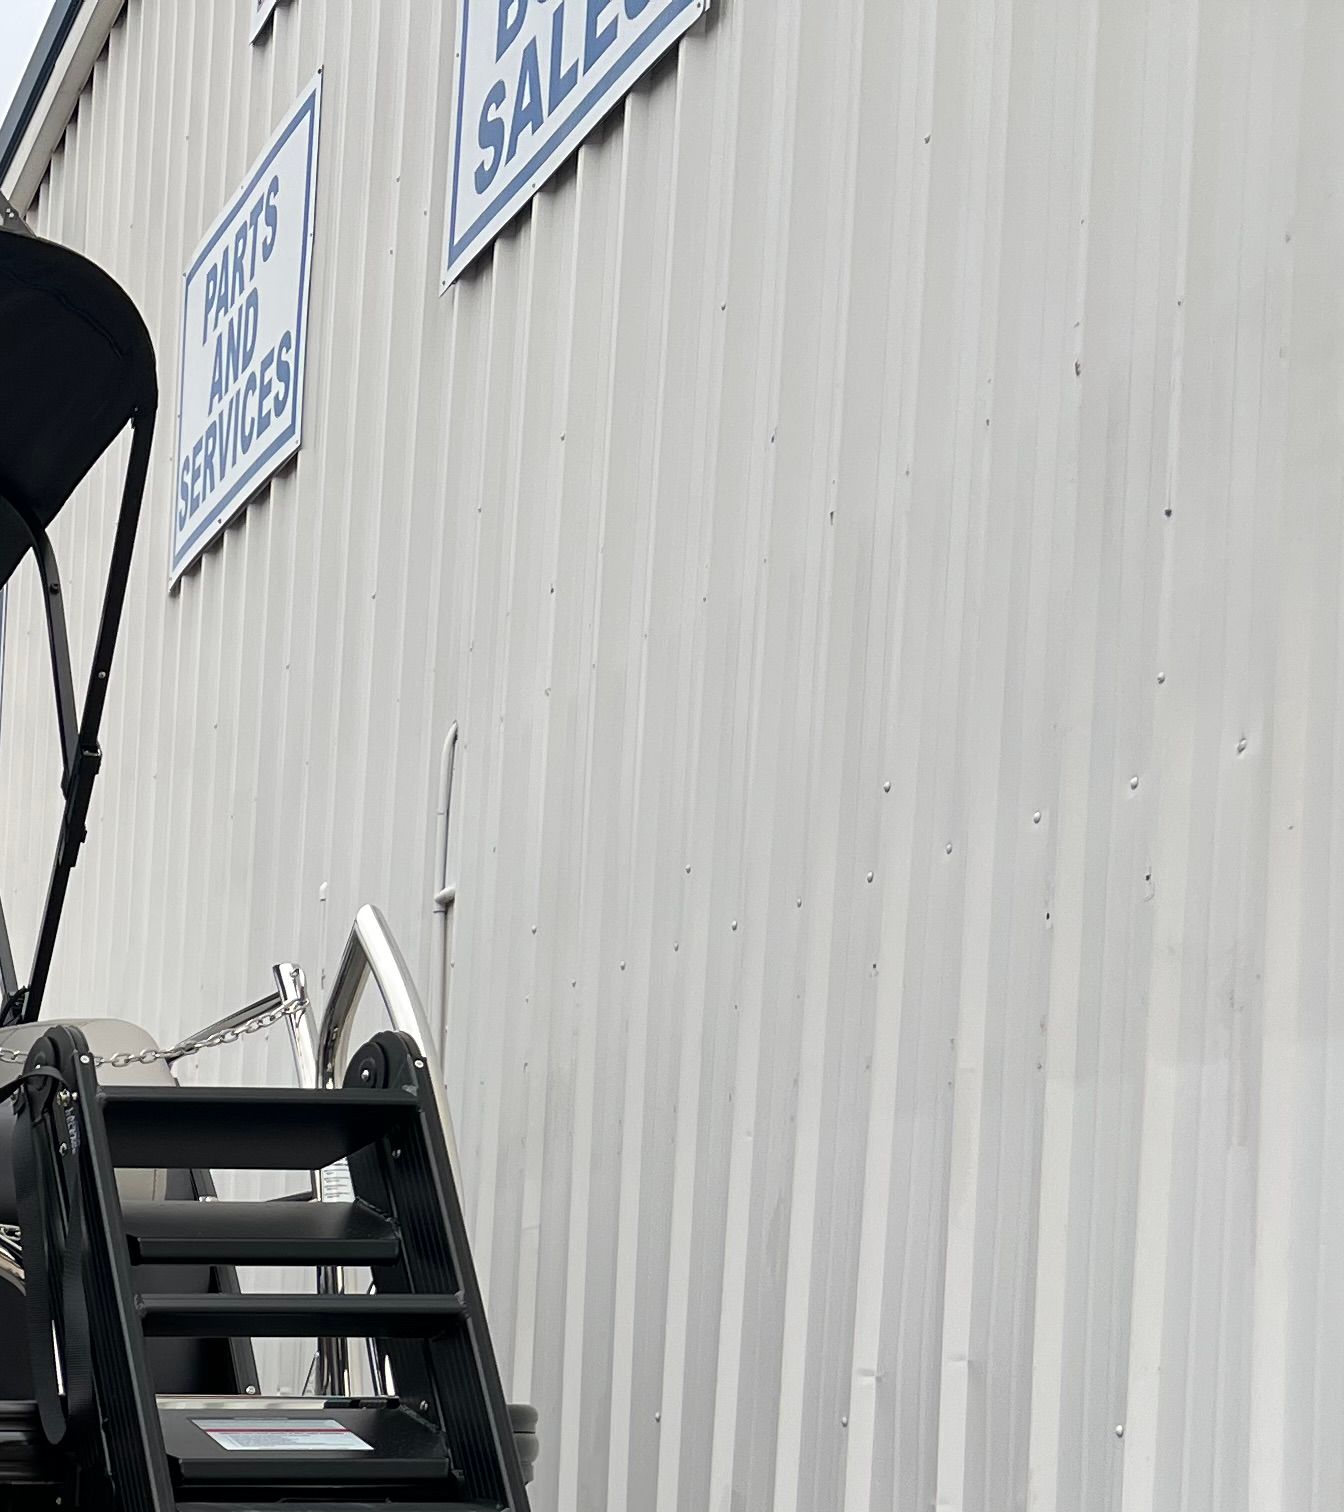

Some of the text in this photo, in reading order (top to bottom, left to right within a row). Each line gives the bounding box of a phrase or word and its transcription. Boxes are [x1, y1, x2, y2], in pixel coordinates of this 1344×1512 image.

[474, 0, 659, 195] SALE
[202, 175, 279, 346] PARTS
[208, 287, 259, 417] AND
[177, 330, 293, 532] SERVICES
